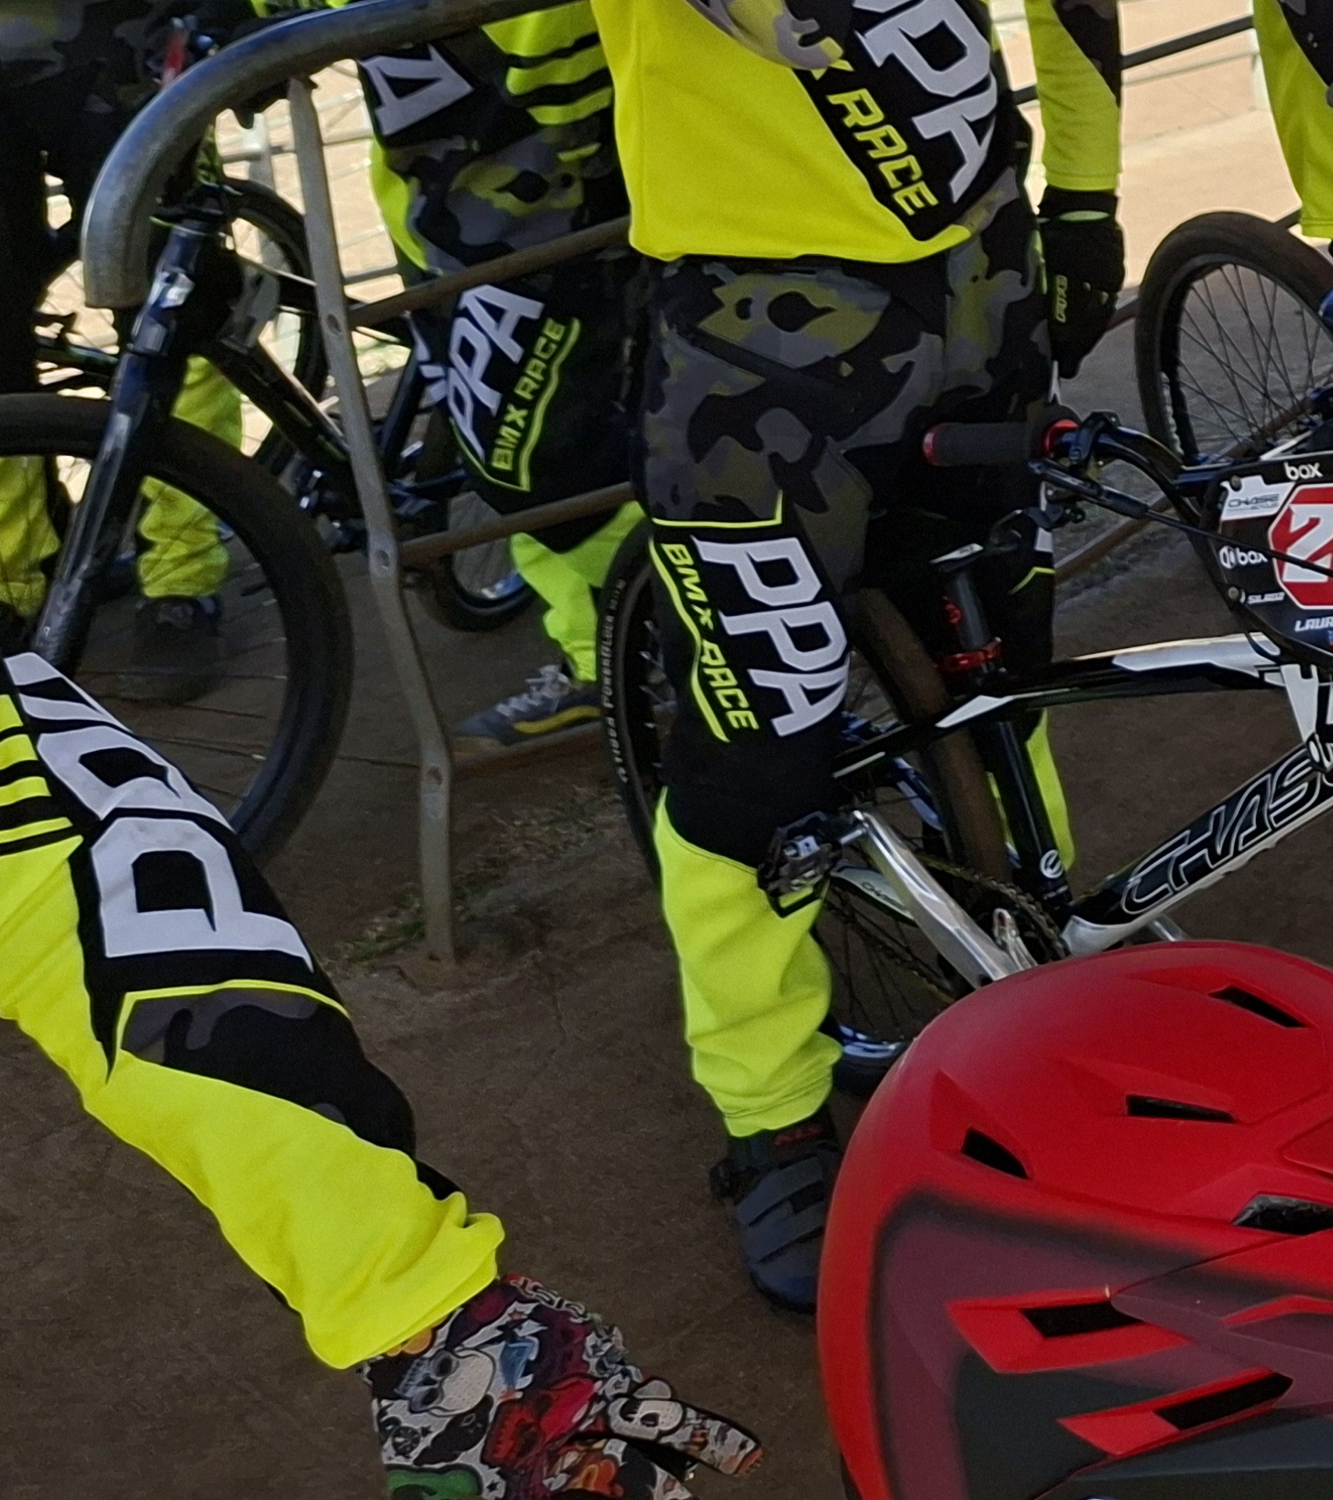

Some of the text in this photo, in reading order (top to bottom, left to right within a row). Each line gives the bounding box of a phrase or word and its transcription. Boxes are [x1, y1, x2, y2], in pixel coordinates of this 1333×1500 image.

[826, 87, 938, 216] RACE
[491, 317, 565, 473] BMX RACE
[1283, 462, 1324, 481] box
[660, 542, 760, 730] BMX RACE
[690, 534, 850, 738] PPA
